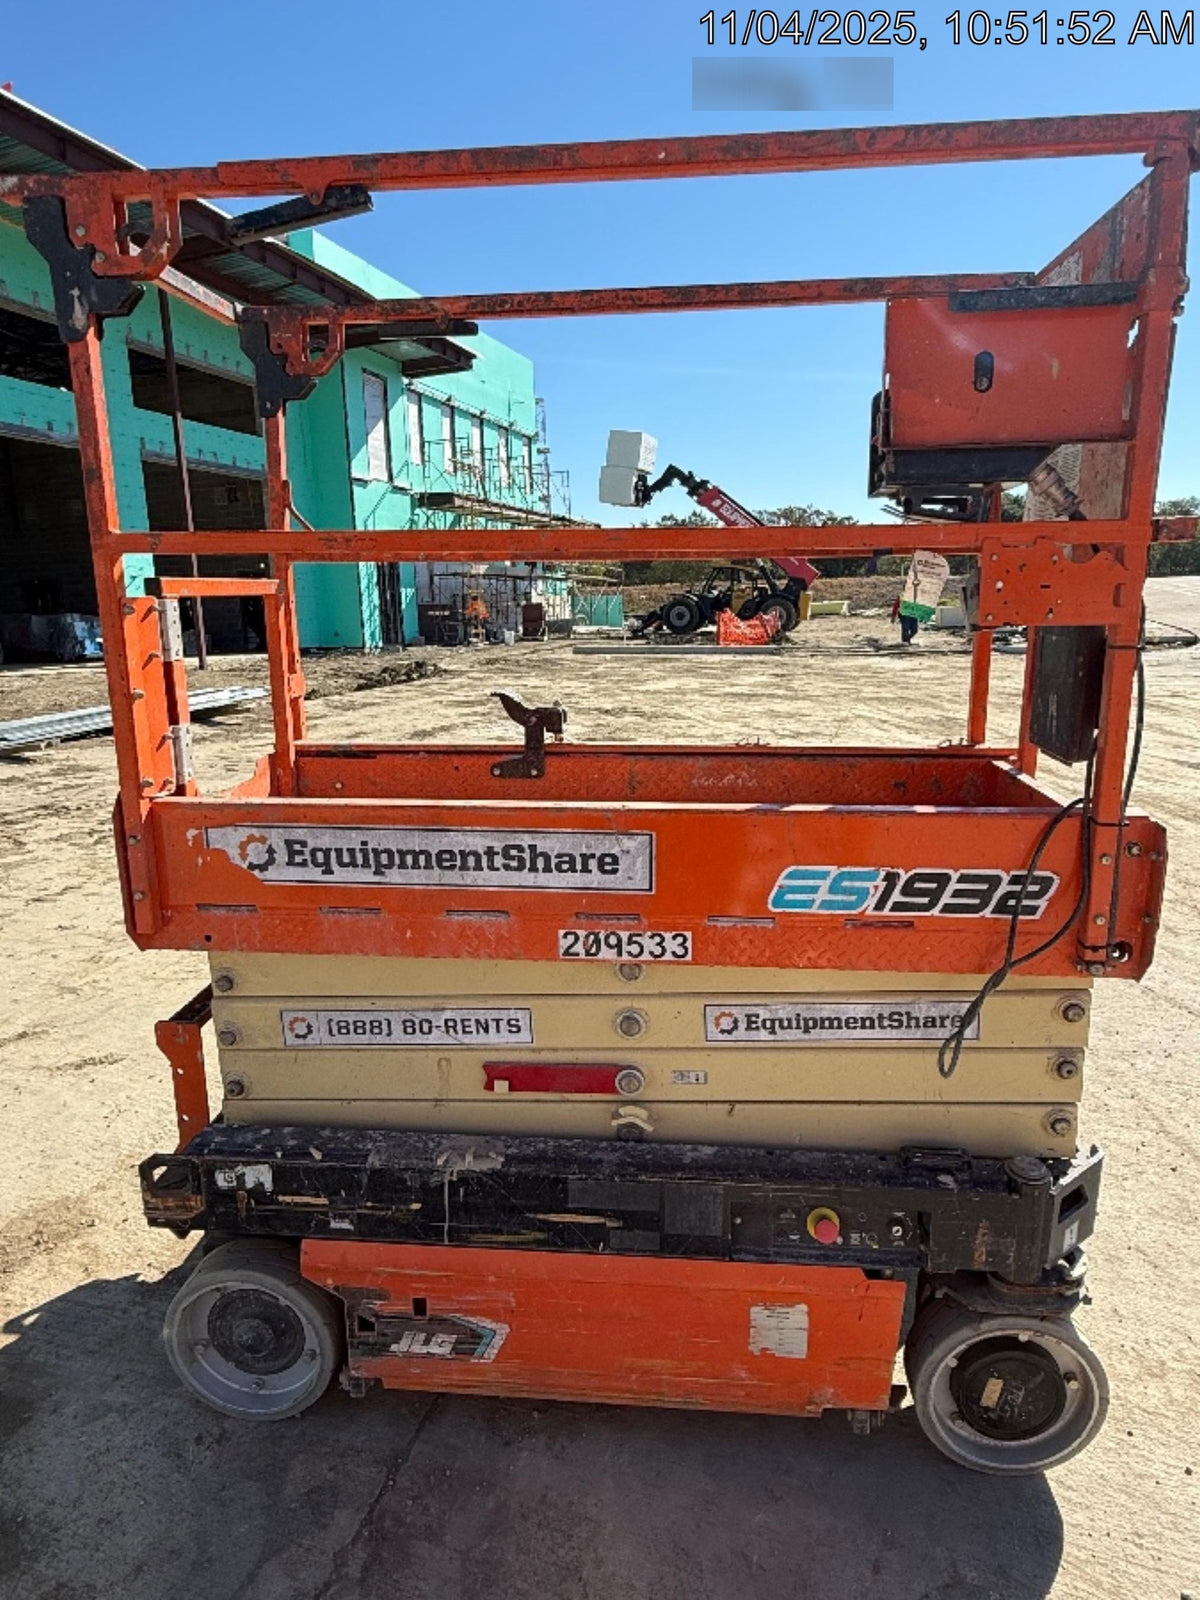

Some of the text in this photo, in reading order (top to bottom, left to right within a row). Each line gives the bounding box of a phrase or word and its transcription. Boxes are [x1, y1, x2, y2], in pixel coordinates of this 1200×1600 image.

[284, 838, 620, 876] EquipmentShare
[773, 868, 1055, 916] ES1932
[561, 931, 690, 958] 209533
[327, 1018, 522, 1037] (888) 80-RENTS
[744, 1011, 966, 1034] EquipmentShare
[390, 1331, 457, 1357] JLG
